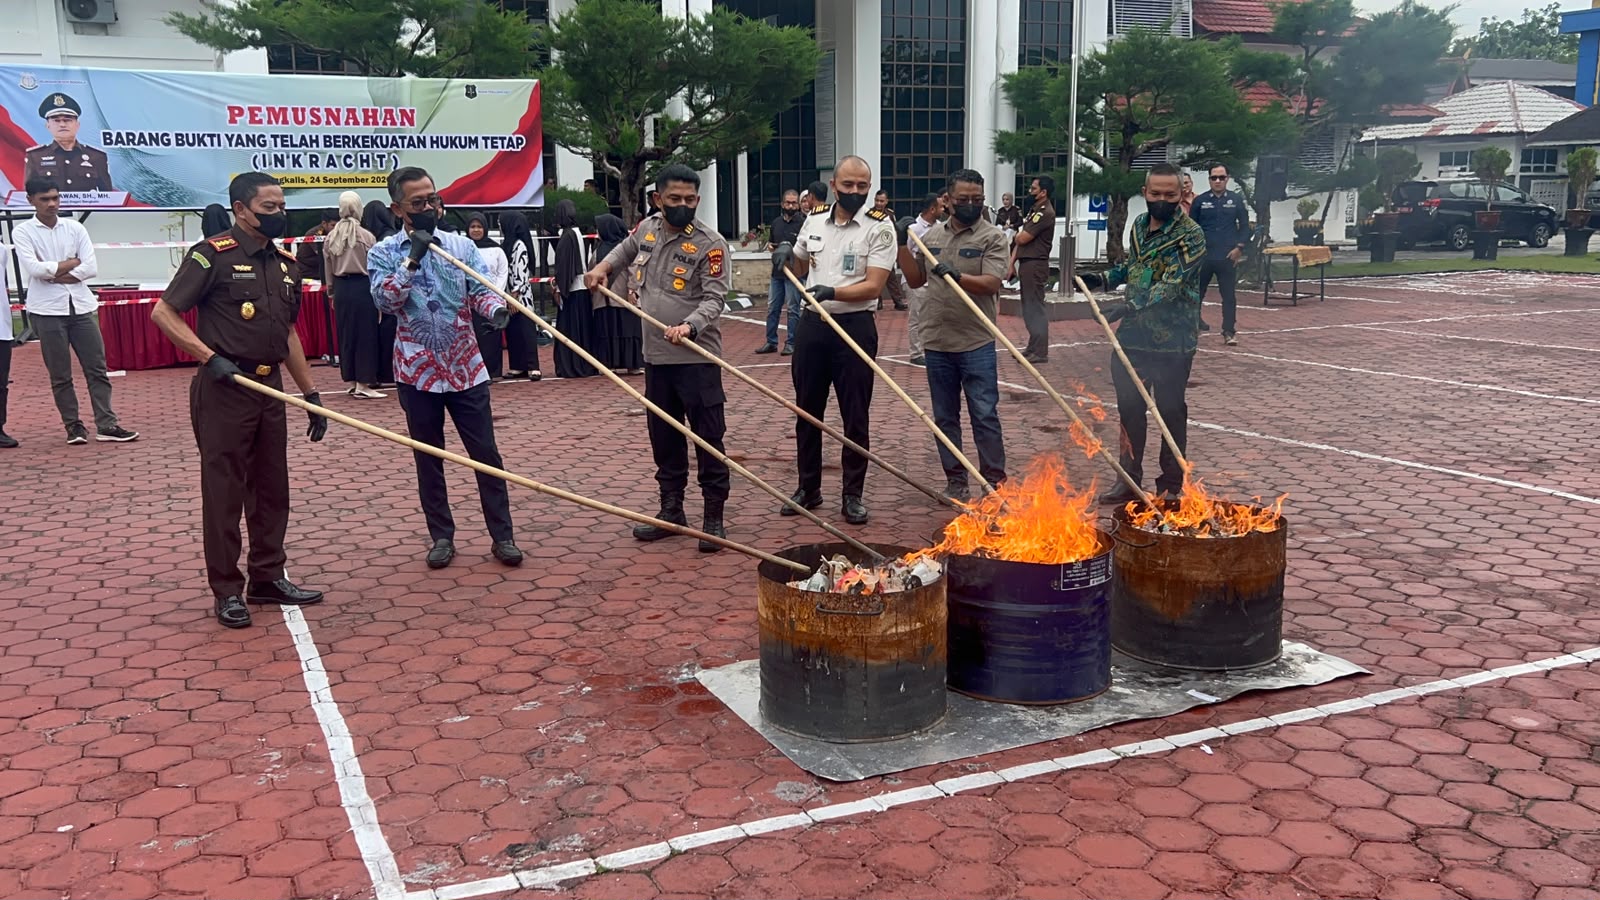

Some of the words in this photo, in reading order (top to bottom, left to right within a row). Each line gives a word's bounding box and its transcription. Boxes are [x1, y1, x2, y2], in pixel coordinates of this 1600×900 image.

[227, 105, 416, 127] PEMUSNAHAN
[102, 131, 171, 147] BARANG
[174, 133, 222, 147] BUKTI
[224, 133, 267, 148] YANG
[270, 134, 319, 148] TELAH
[322, 134, 427, 149] BERKEKUATAN
[429, 135, 479, 149] HUKUM
[481, 135, 525, 150] TETAP
[251, 153, 399, 170] (INKRACHT)
[279, 175, 308, 185] gkalis,
[309, 175, 321, 184] 24
[322, 175, 369, 186] September
[370, 175, 389, 184] 202
[673, 253, 696, 266] POLRI
